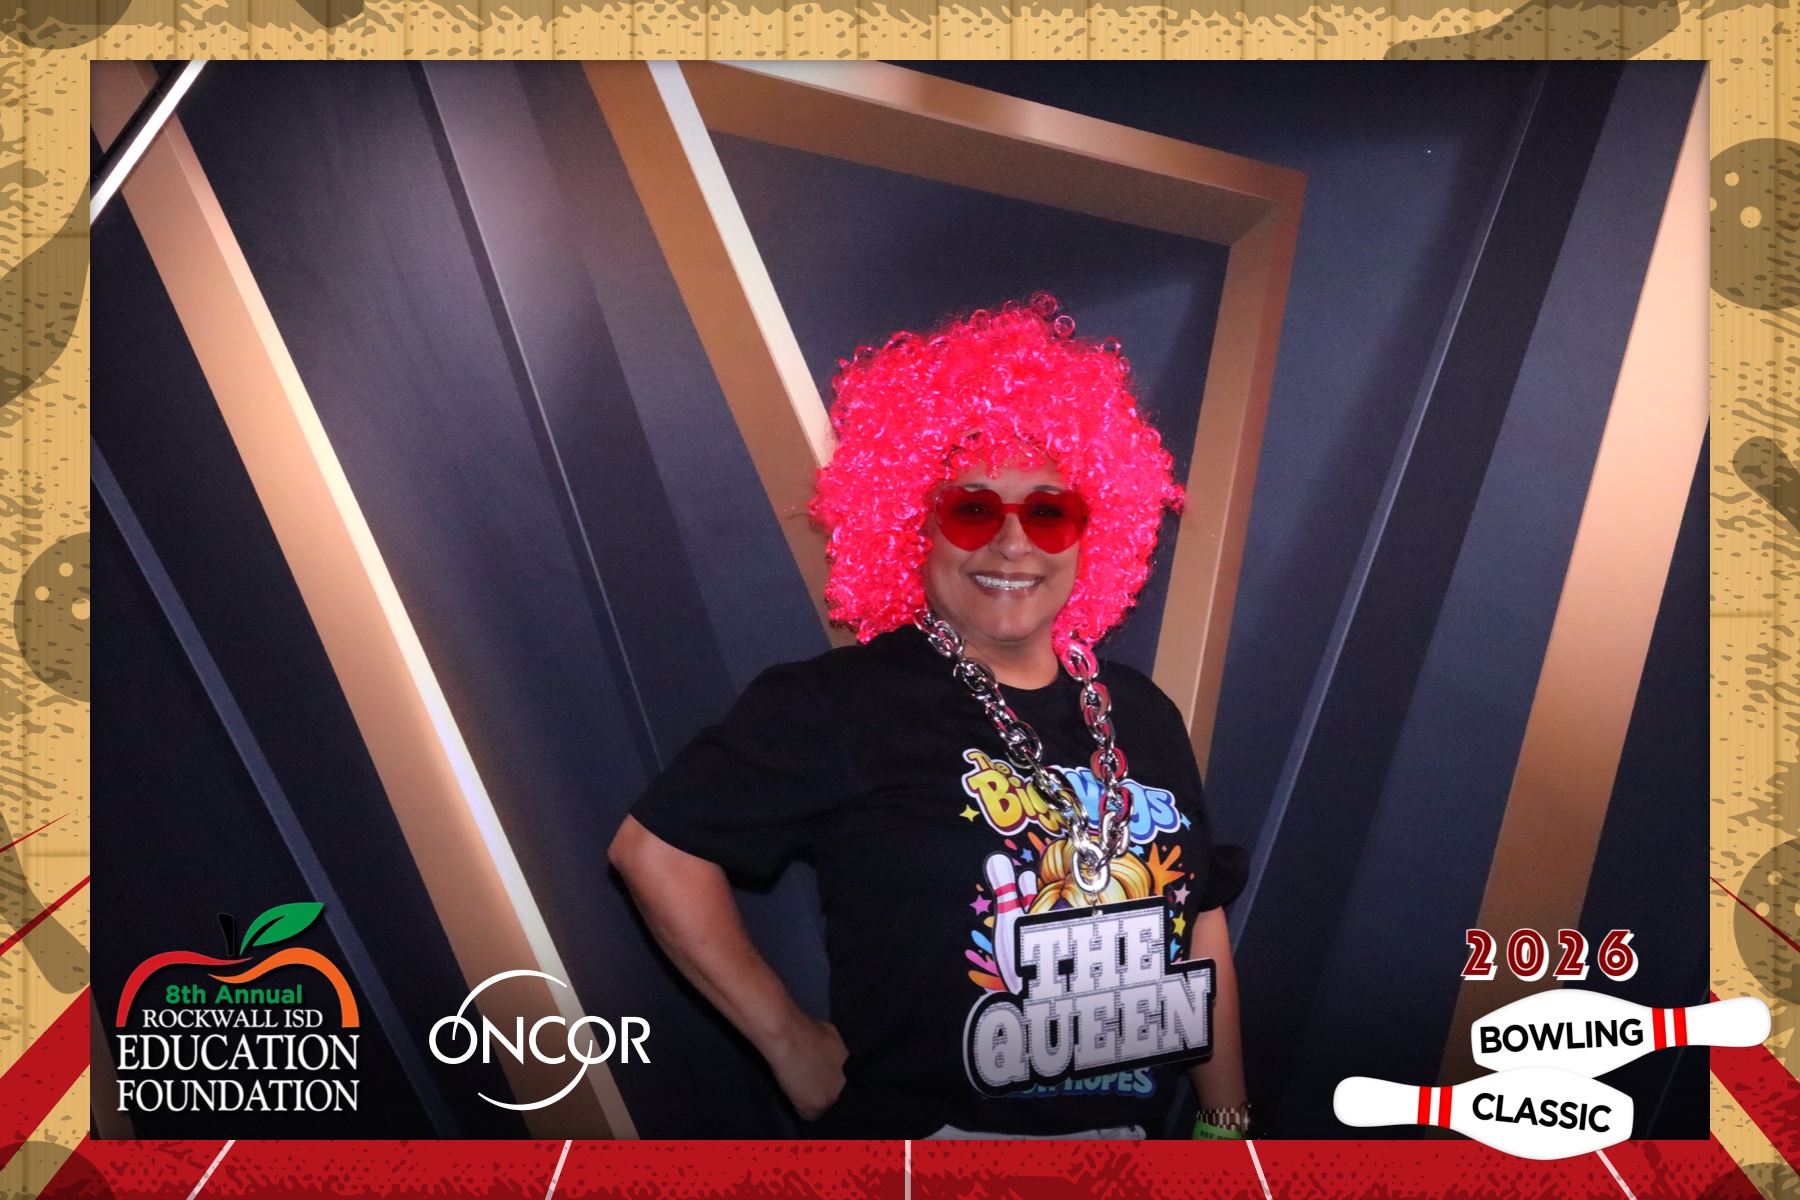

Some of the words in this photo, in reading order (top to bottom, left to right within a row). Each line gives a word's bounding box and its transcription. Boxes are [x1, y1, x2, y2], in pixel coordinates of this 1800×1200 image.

[1052, 768, 1178, 840] Wgs
[1019, 906, 1165, 1000] THE
[973, 967, 1212, 1087] QUEEN
